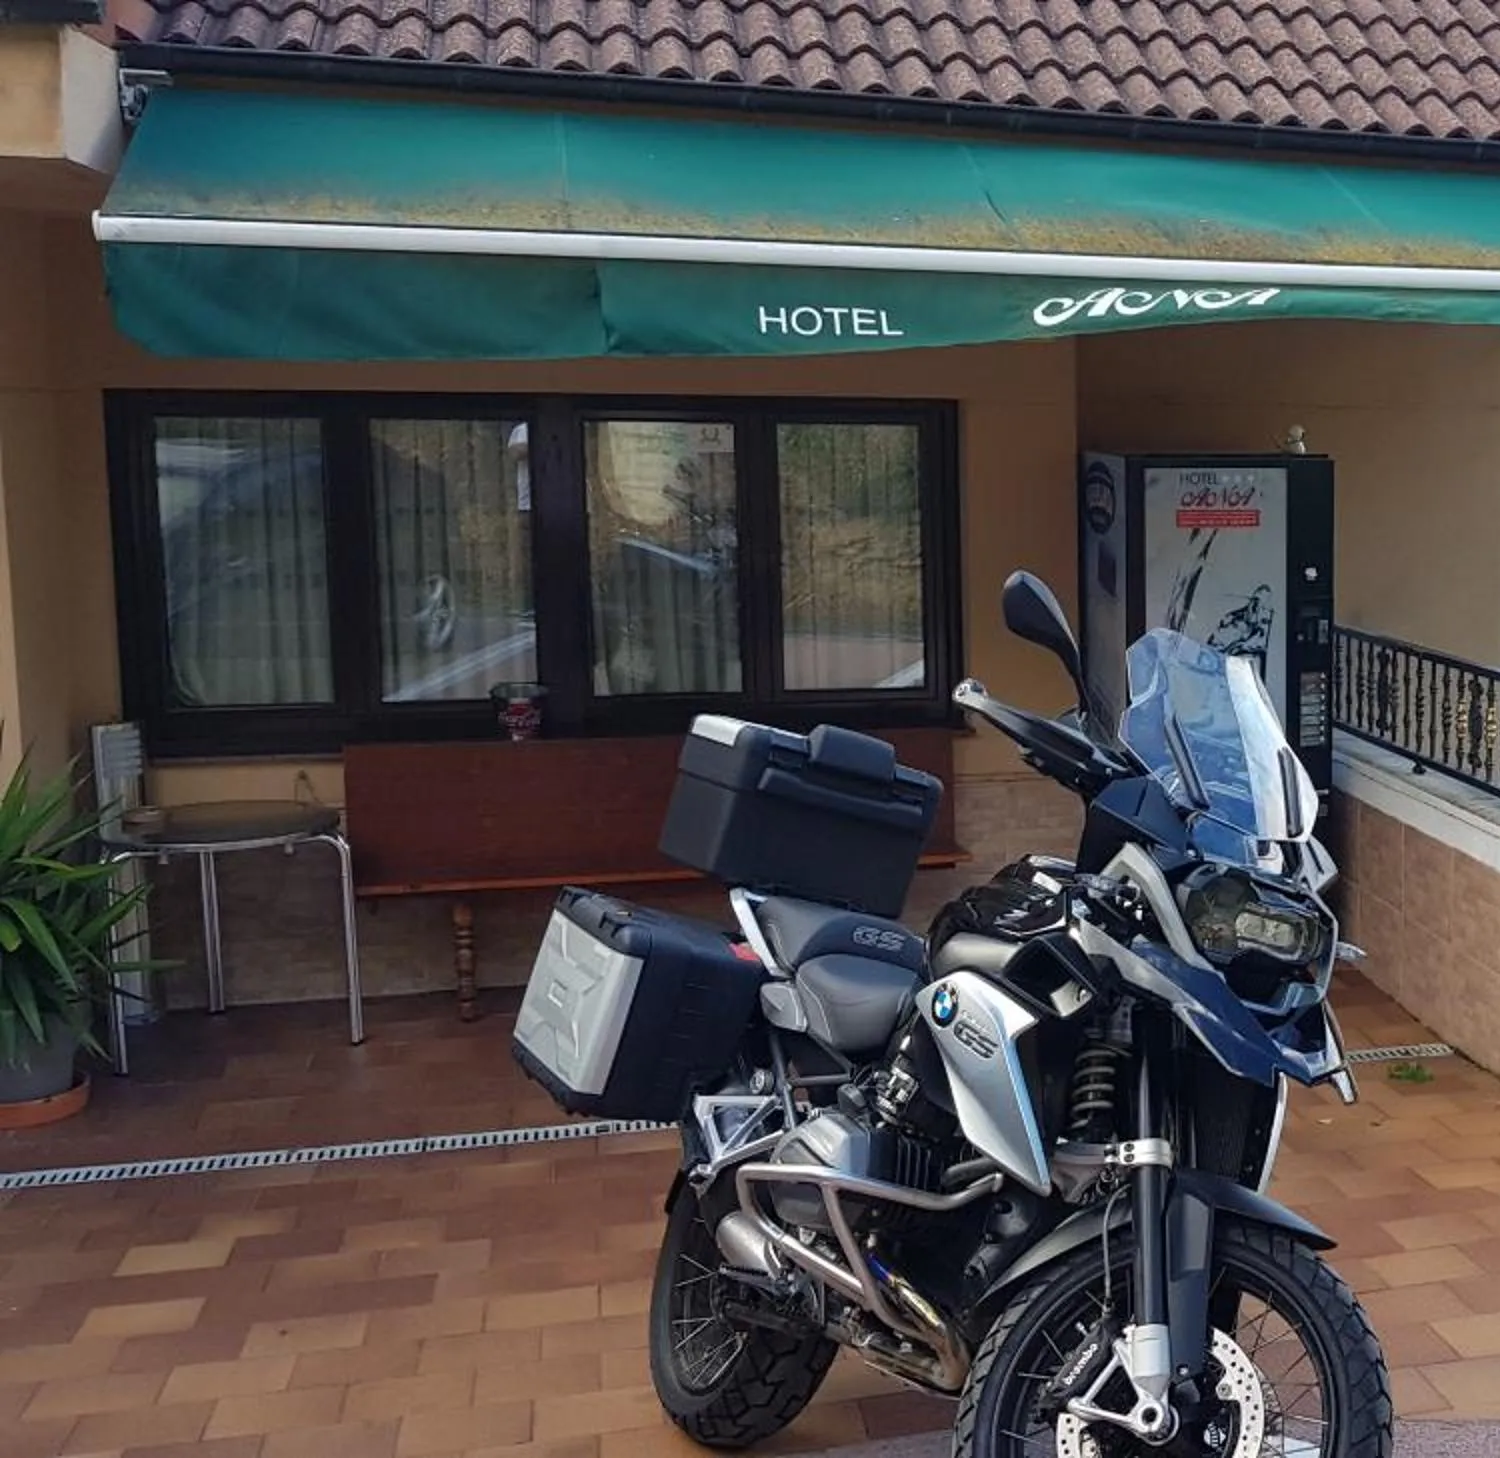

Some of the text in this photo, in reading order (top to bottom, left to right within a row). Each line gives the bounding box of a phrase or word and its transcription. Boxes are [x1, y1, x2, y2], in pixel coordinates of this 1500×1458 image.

[758, 305, 904, 336] HOTEL
[853, 926, 905, 951] GS
[953, 1020, 999, 1059] GS
[1062, 1343, 1099, 1386] brembo
